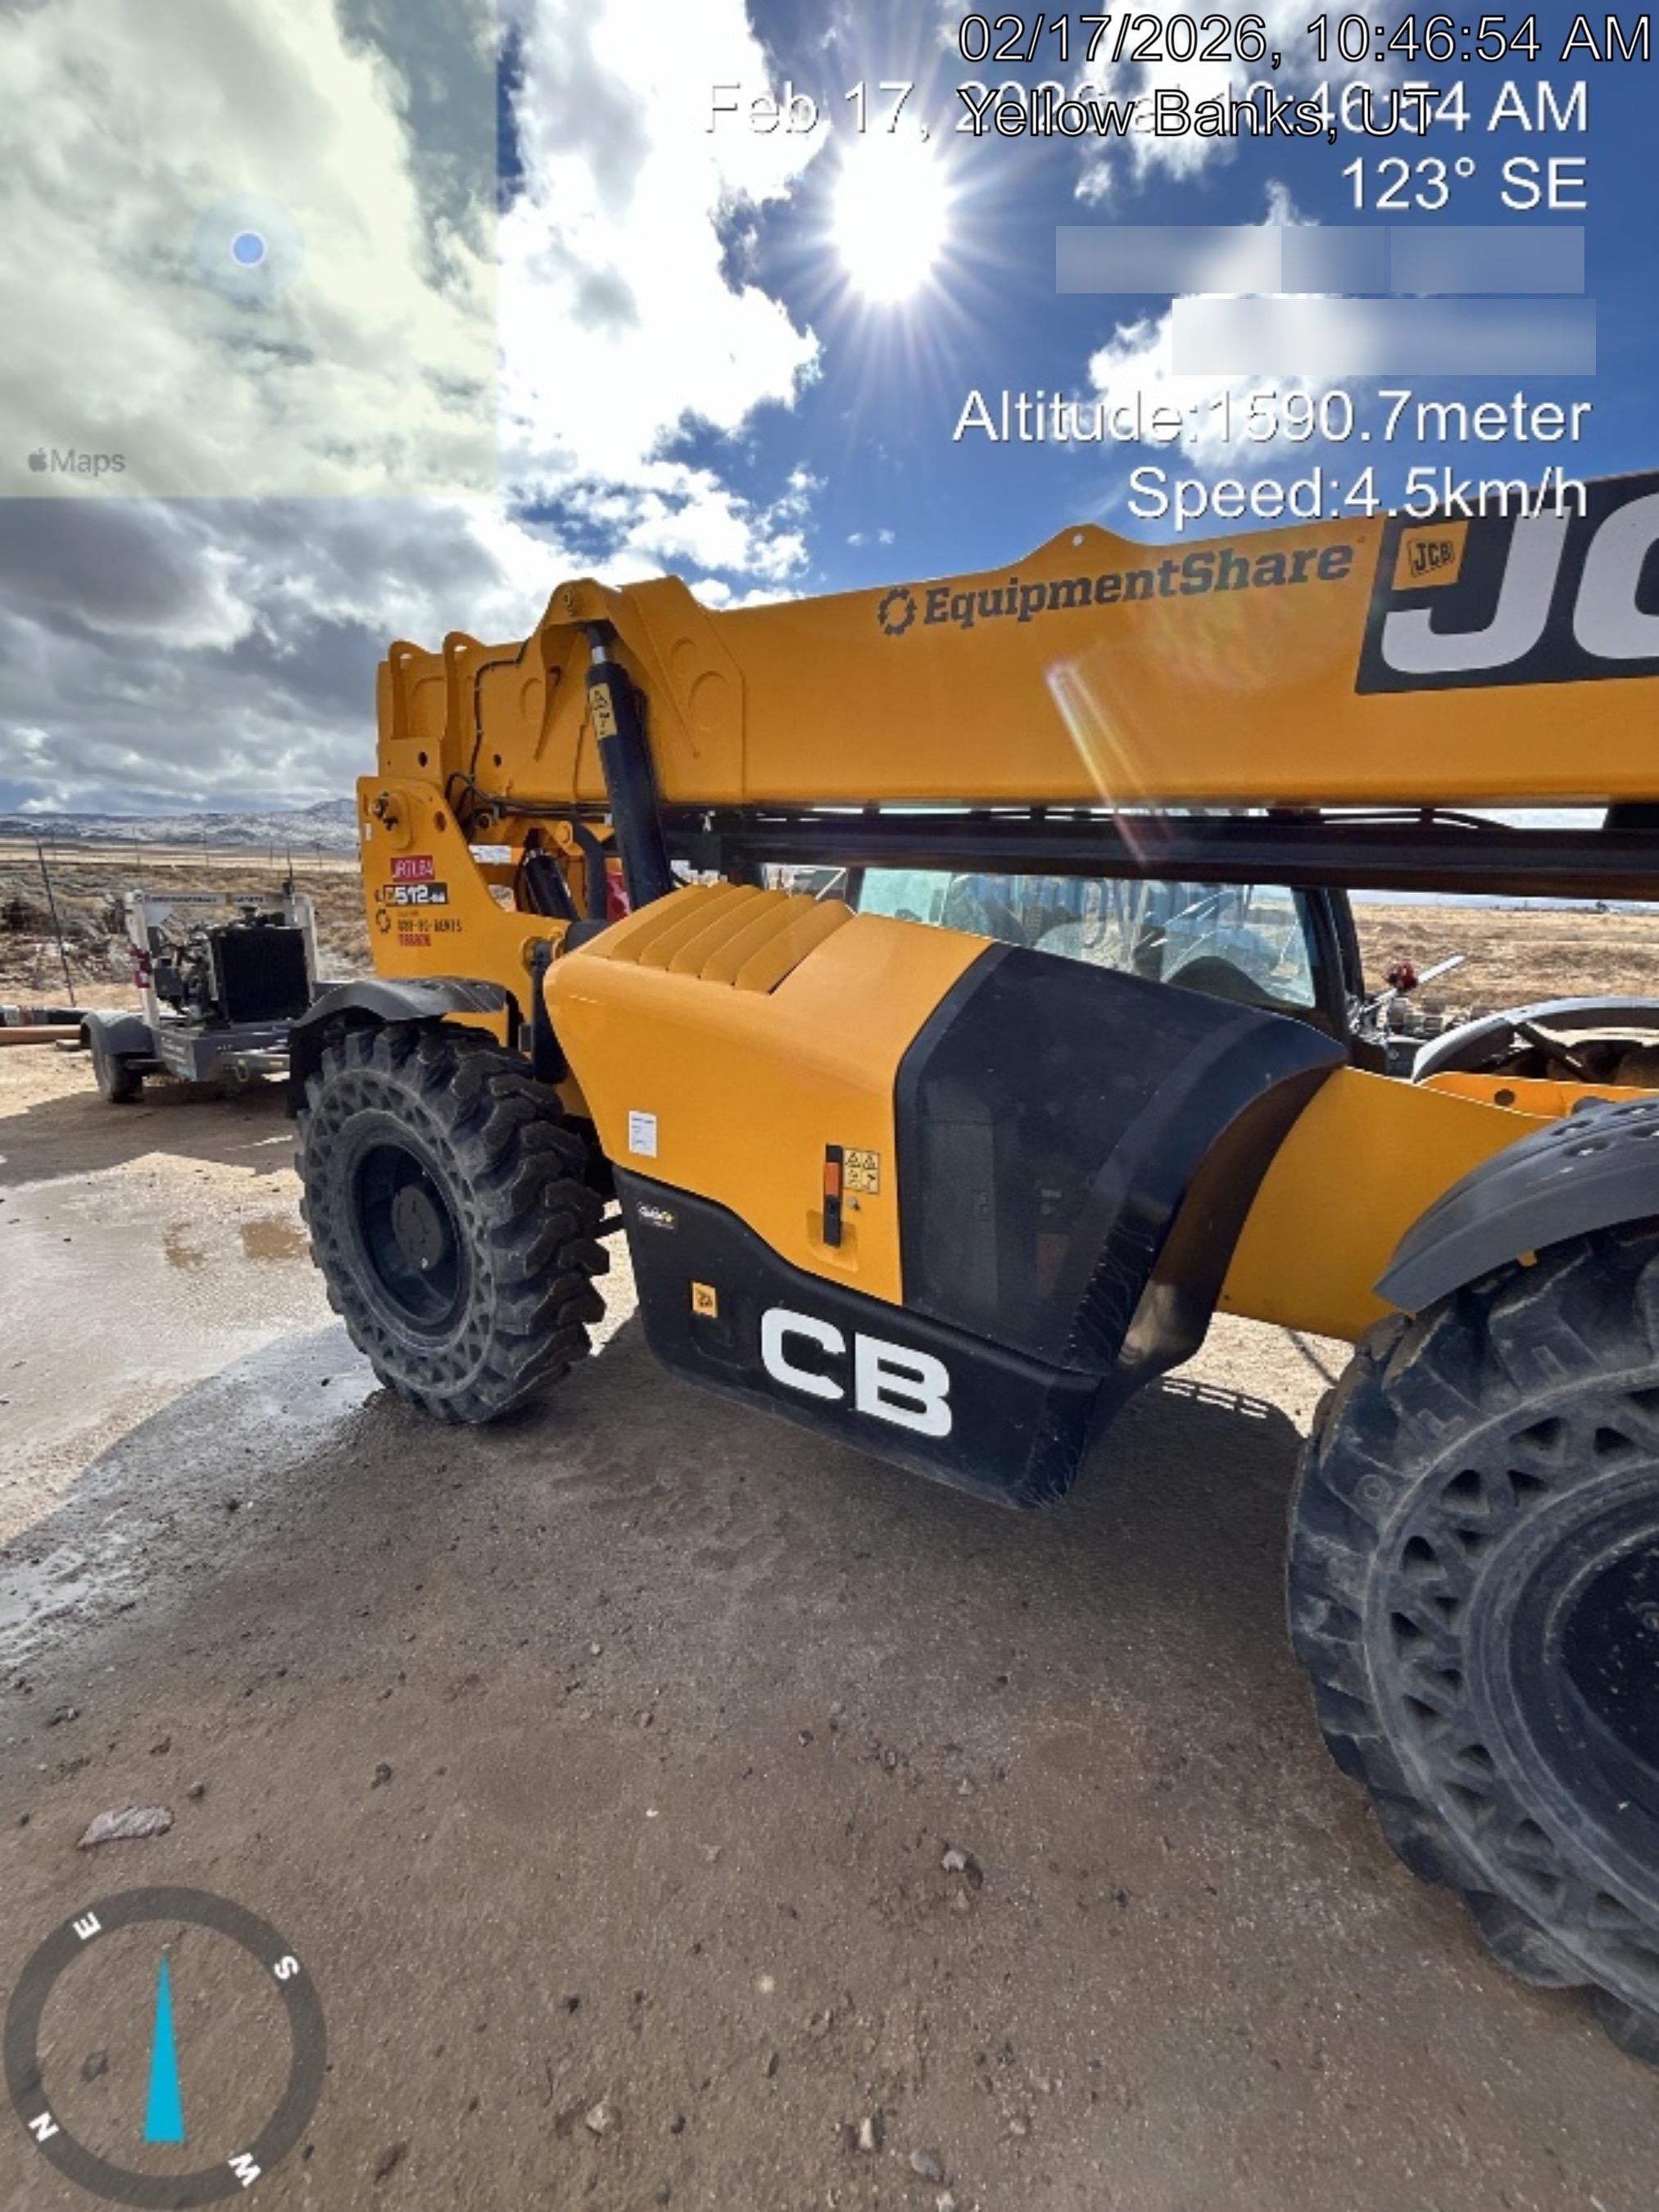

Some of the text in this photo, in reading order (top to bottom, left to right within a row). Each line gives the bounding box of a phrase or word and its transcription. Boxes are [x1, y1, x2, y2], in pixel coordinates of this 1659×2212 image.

[923, 545, 1353, 630] EquipmentShare
[1413, 541, 1453, 572] JCB
[761, 1308, 953, 1438] CB
